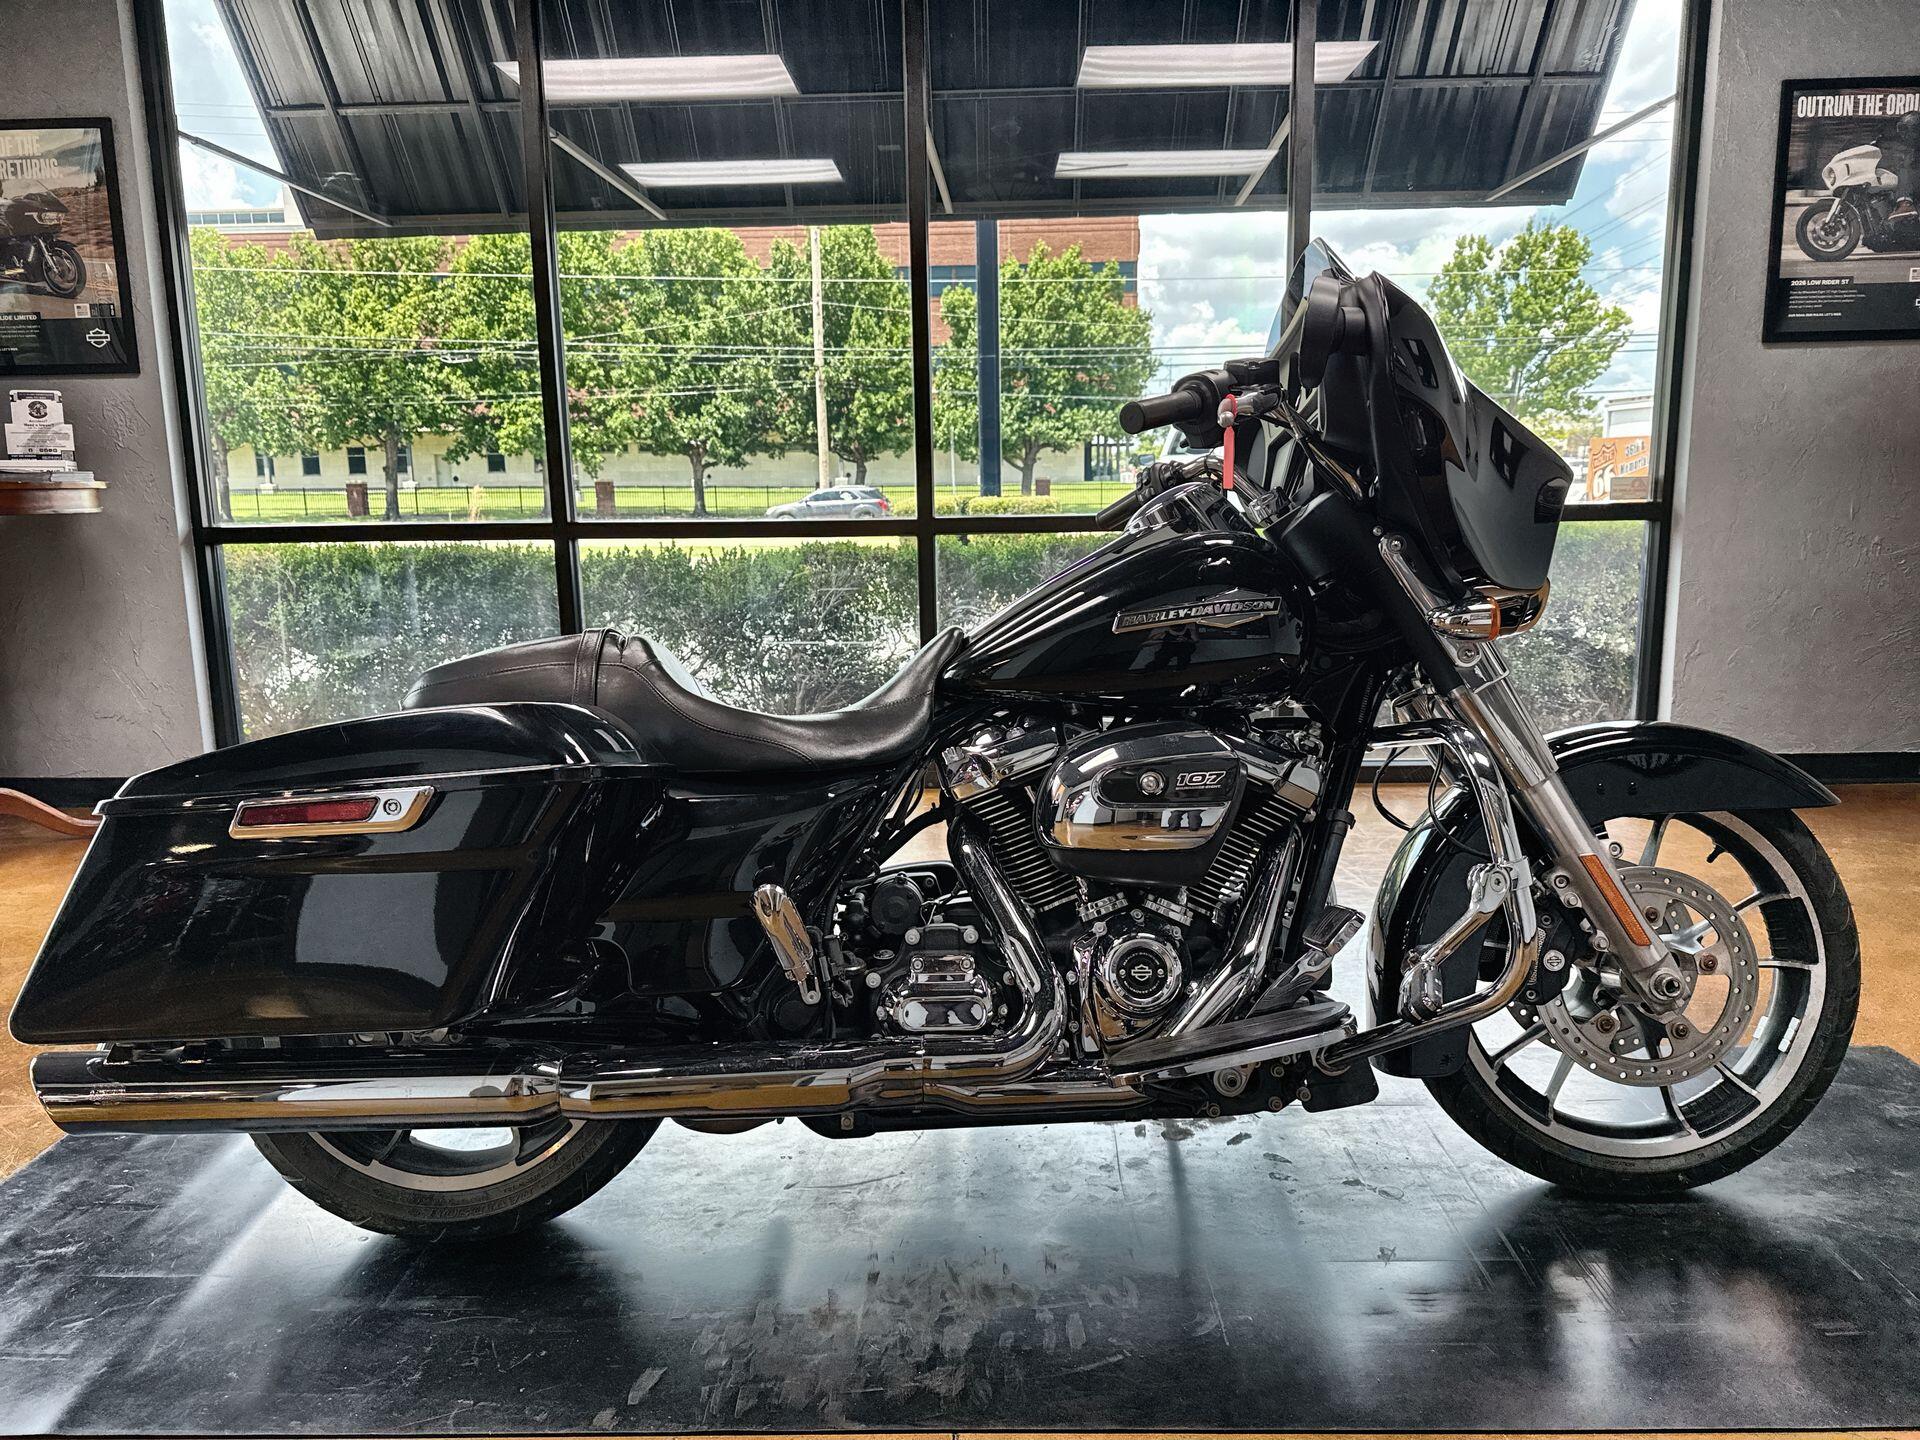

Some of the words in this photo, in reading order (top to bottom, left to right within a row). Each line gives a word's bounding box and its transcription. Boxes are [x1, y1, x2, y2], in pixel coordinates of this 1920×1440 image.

[1797, 95, 1855, 118] OUTRUN
[1857, 94, 1883, 116] THE
[1886, 93, 1920, 115] ORDI
[1122, 600, 1275, 627] HARLEY-DAVIDSON
[1176, 771, 1226, 786] 107
